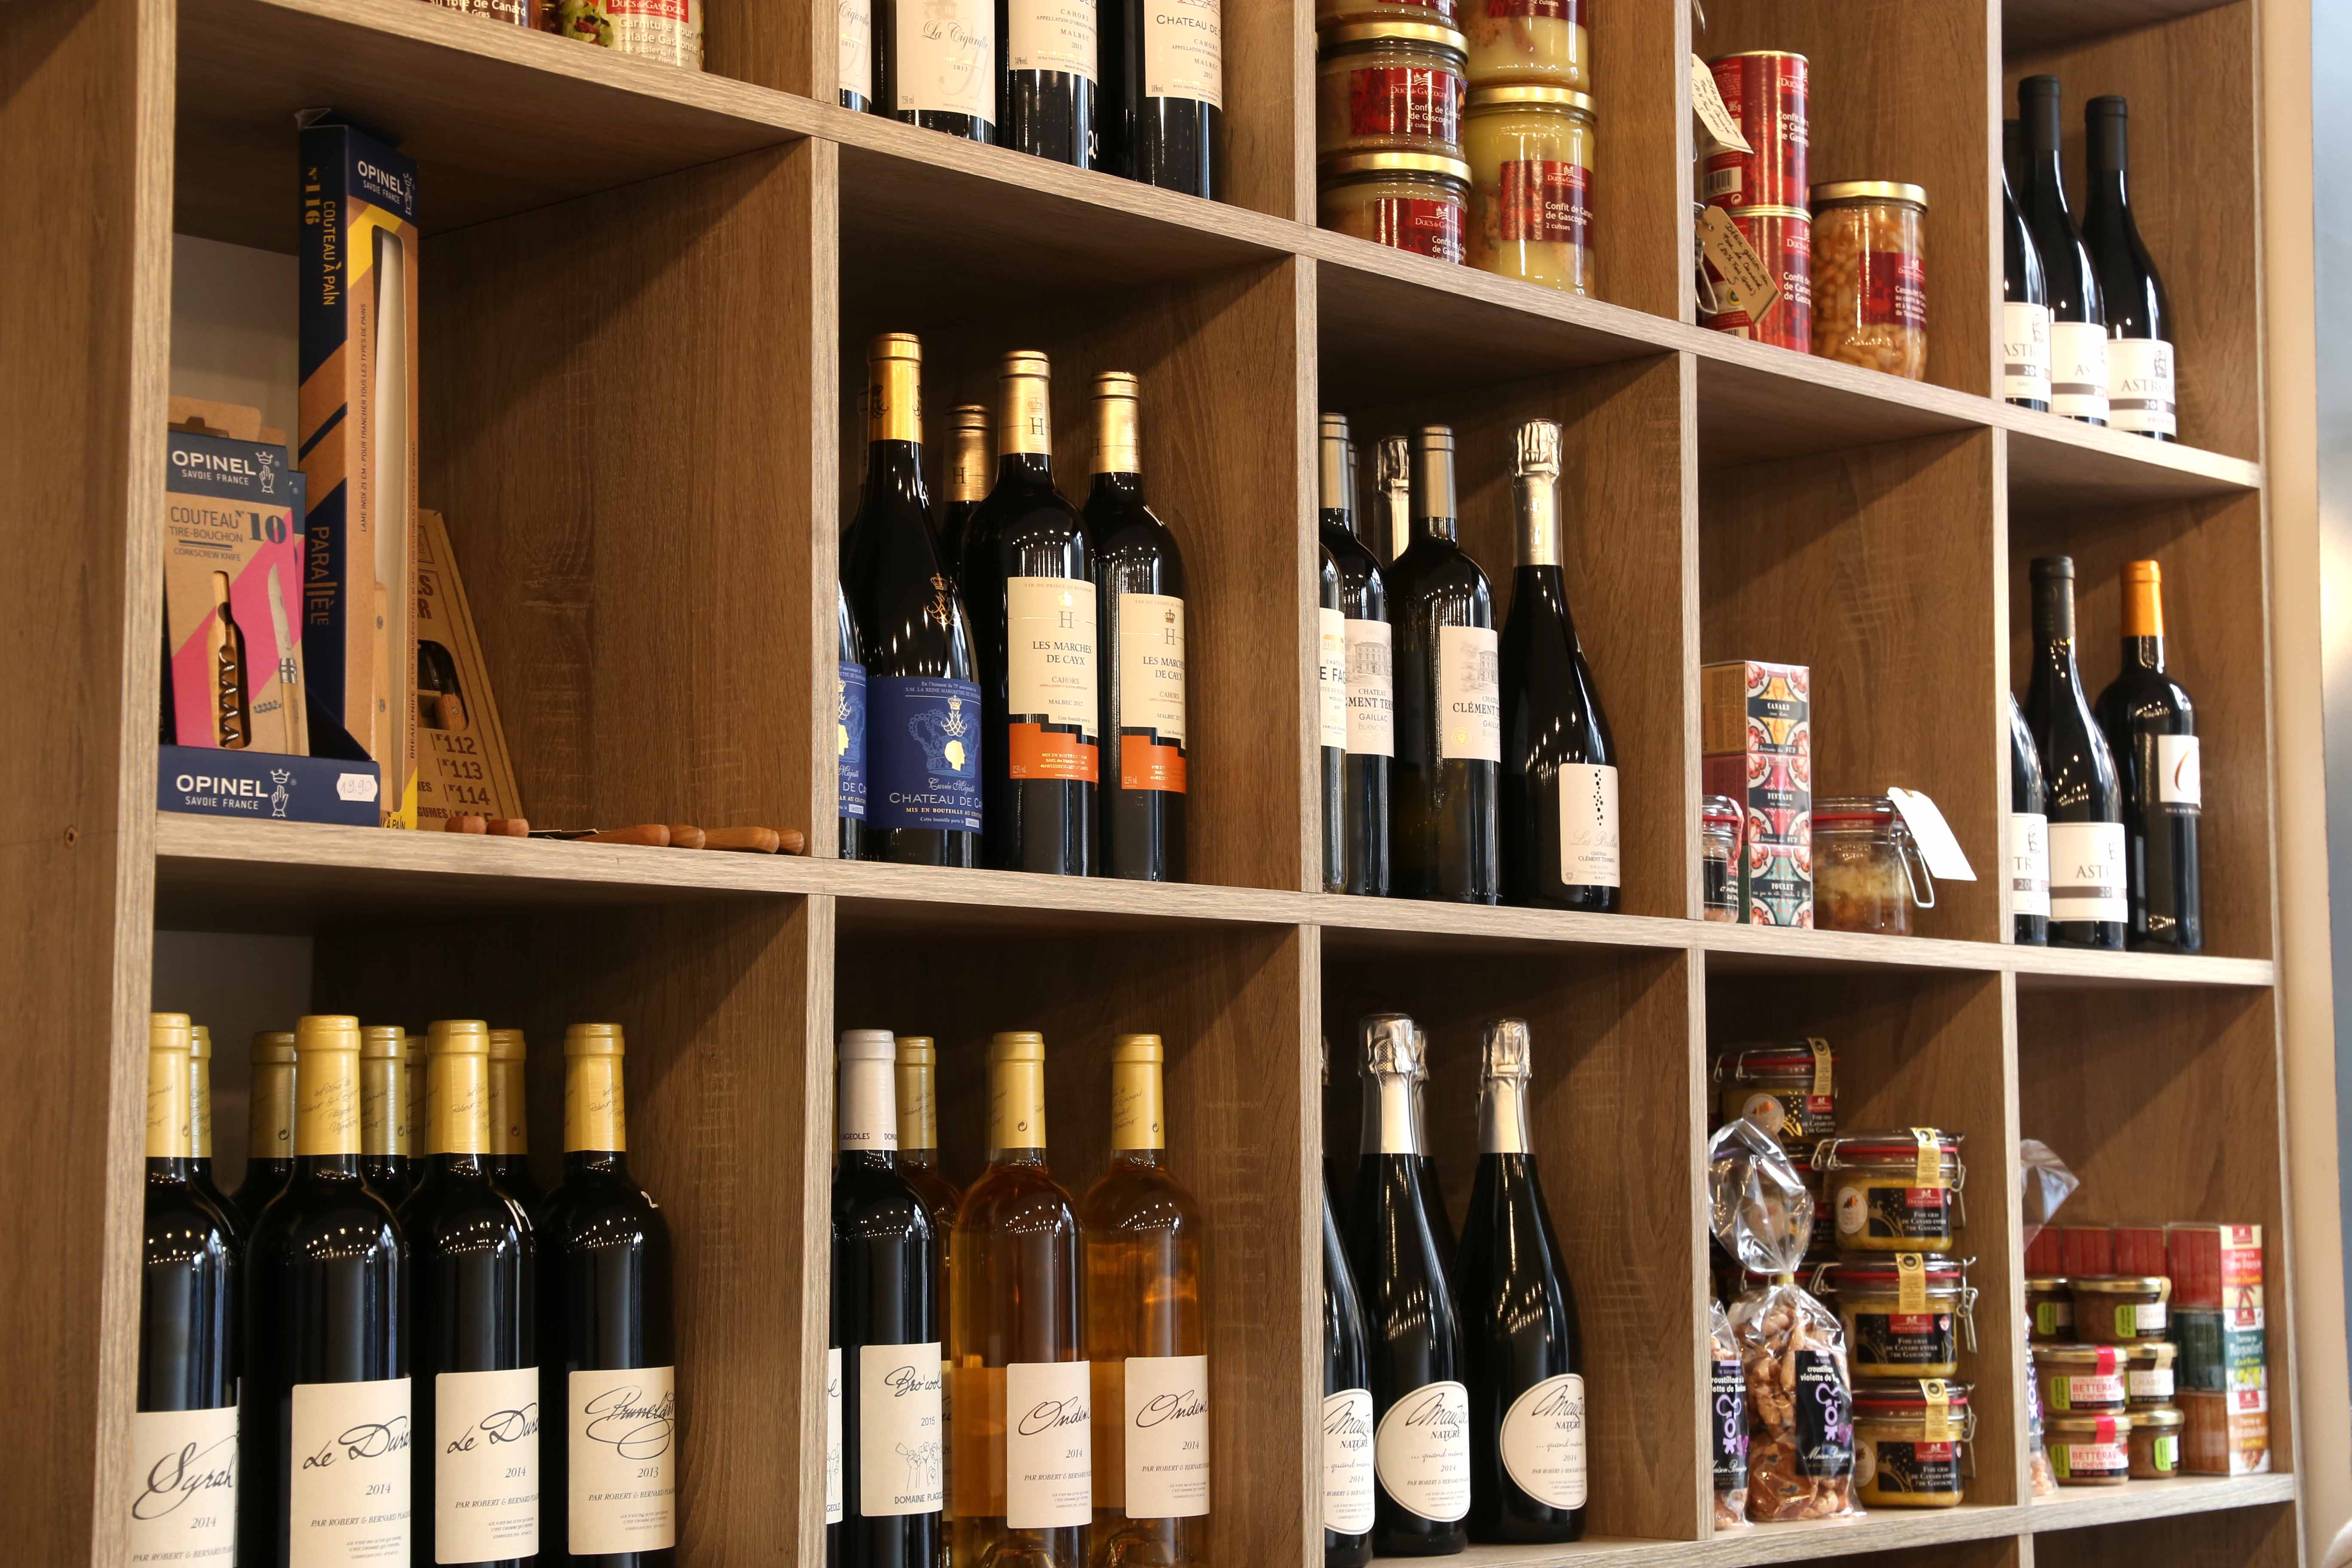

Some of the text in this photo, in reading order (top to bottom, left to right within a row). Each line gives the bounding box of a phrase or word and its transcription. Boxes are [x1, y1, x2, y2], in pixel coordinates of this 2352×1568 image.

[1060, 9, 1089, 21] CAHORS
[921, 20, 943, 40] La
[1156, 14, 1218, 36] CHATEAU DE
[1060, 28, 1090, 42] MALBEC
[1072, 42, 1082, 50] 2011
[1194, 38, 1218, 52] CAHORS
[1194, 58, 1218, 71] MALBEC
[1204, 71, 1213, 80] 2011
[1410, 112, 1421, 120] de
[357, 160, 404, 195] OPINEL
[363, 180, 401, 205] SAVOIE FRANCE
[304, 184, 322, 225] 116
[1545, 202, 1579, 214] Confit de
[1546, 211, 1556, 220] de
[323, 200, 336, 262] COUTEAU
[1551, 222, 1571, 231] cuisses
[1784, 271, 1804, 282] Confit
[323, 276, 340, 306] PAIN
[1030, 417, 1044, 435] H
[172, 450, 257, 476] OPINEL
[181, 469, 249, 486] SAVOIE FRANCE
[171, 506, 287, 545] COUTEAU 10
[169, 526, 243, 544] TIRE-BOUCHON
[173, 548, 241, 561] CORKSCREW KNIFE
[1058, 610, 1075, 629] H
[1164, 628, 1176, 646] H
[1032, 641, 1092, 654] LES MARCHES
[1047, 655, 1085, 666] DE CAYX
[1143, 656, 1158, 665] LES
[1052, 676, 1080, 685] CAHORS
[1155, 670, 1183, 682] DE CAYX
[1160, 691, 1180, 699] CAHORS
[1359, 688, 1387, 696] CHATEAU
[1453, 701, 1495, 714] CLÉMENT
[1359, 713, 1388, 722] GAILLAC
[445, 735, 478, 755] 112
[451, 761, 484, 780] 113
[176, 774, 268, 798] OPINEL
[843, 782, 856, 792] DE
[928, 777, 952, 790] Cuvée
[456, 786, 490, 805] 114
[889, 793, 972, 807] CHATEAU DE
[185, 796, 259, 811] SAVOIE FRANCE
[921, 1416, 936, 1427] 2015
[447, 1425, 479, 1454] Le
[1430, 1429, 1461, 1439] NATURE
[1182, 1440, 1200, 1451] 2014
[1340, 1439, 1369, 1449] NATURE
[303, 1440, 337, 1470] Le
[1066, 1449, 1083, 1459] 2014
[505, 1467, 527, 1479] 2014
[637, 1467, 659, 1479] 2013
[1156, 1464, 1179, 1472] ROBERT
[132, 1435, 239, 1521] Syrah
[1038, 1473, 1062, 1481] ROBERT
[365, 1482, 392, 1496] 2014
[604, 1492, 632, 1501] ROBERT
[640, 1489, 664, 1498] BERNARD
[455, 1495, 531, 1509] PAR ROBERT BERNARD
[894, 1494, 925, 1505] DOMAINE
[190, 1517, 217, 1529] 2014
[311, 1513, 397, 1528] PAR ROBERT BERNARD
[132, 1551, 185, 1562] PAR ROBERT
